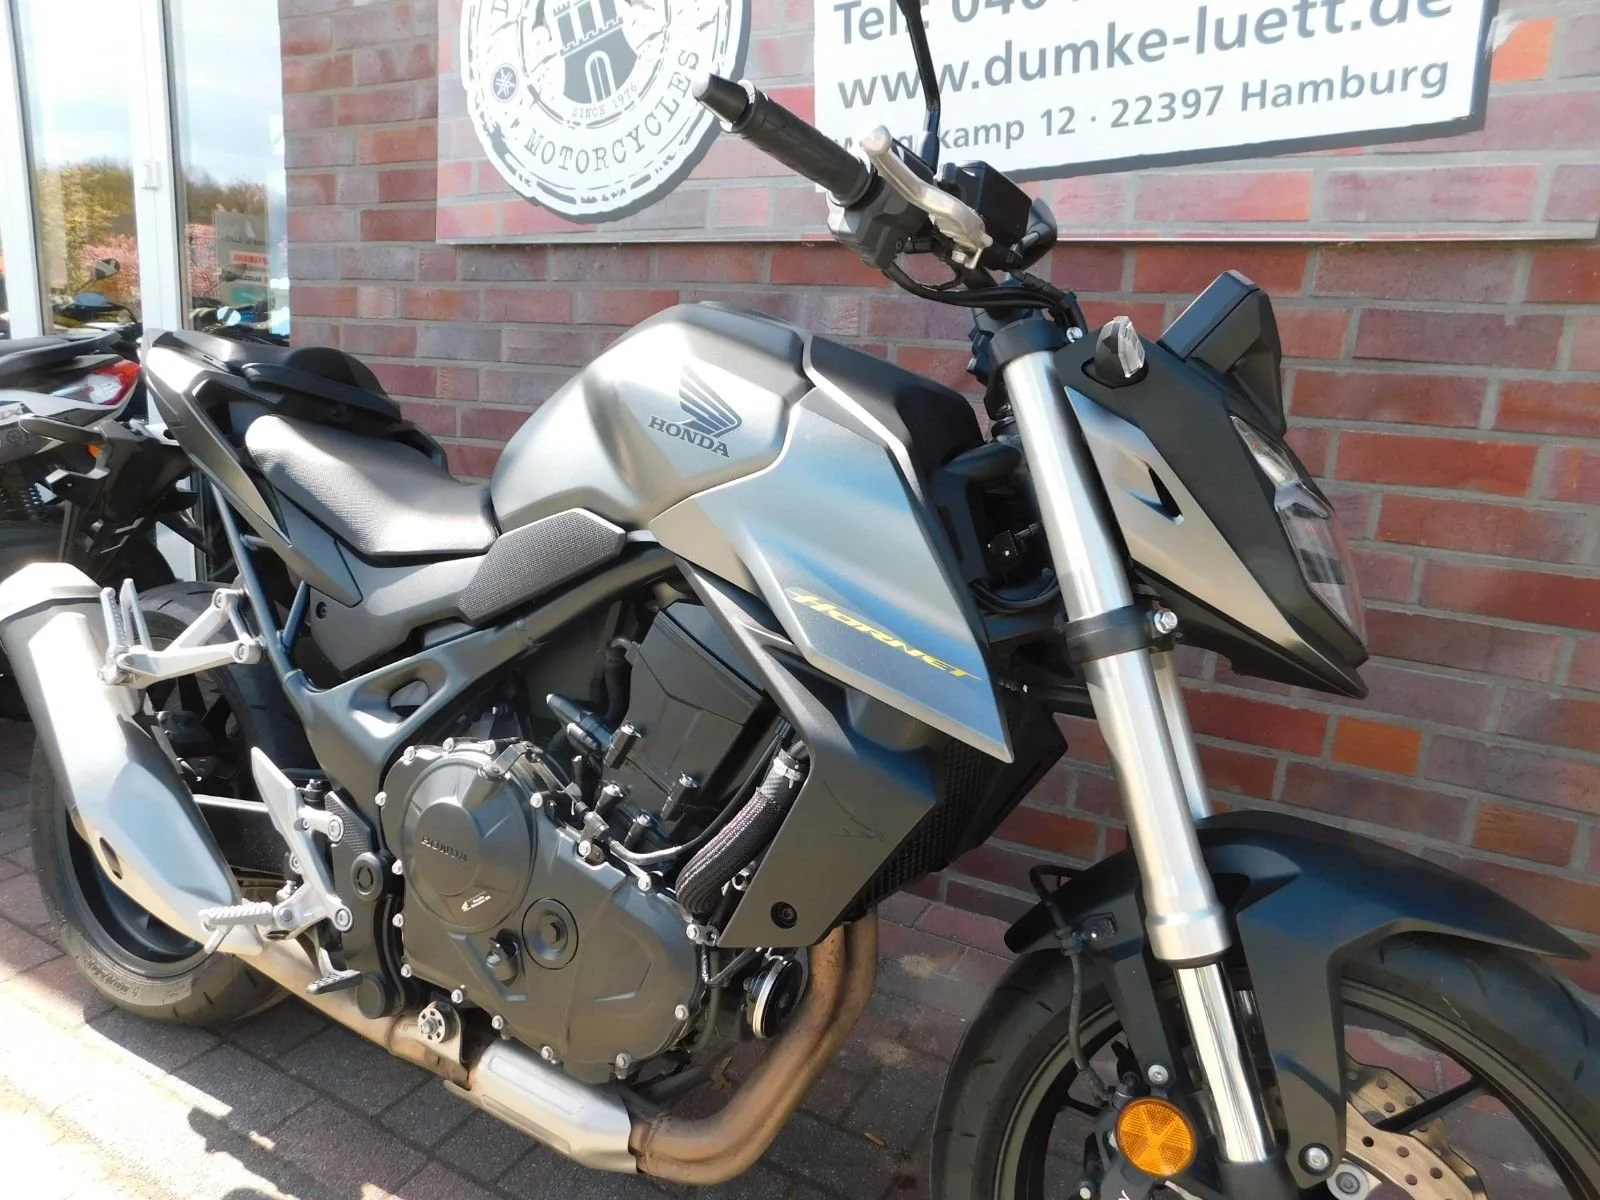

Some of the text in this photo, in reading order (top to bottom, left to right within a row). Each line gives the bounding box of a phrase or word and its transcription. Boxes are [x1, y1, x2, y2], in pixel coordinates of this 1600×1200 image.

[524, 49, 700, 175] MOTORCYCLES
[572, 82, 637, 119] SINCE 1976
[1040, 106, 1076, 137] 12
[1110, 85, 1225, 129] 22397
[1241, 61, 1450, 112] Hamburg
[648, 415, 730, 458] HONDA
